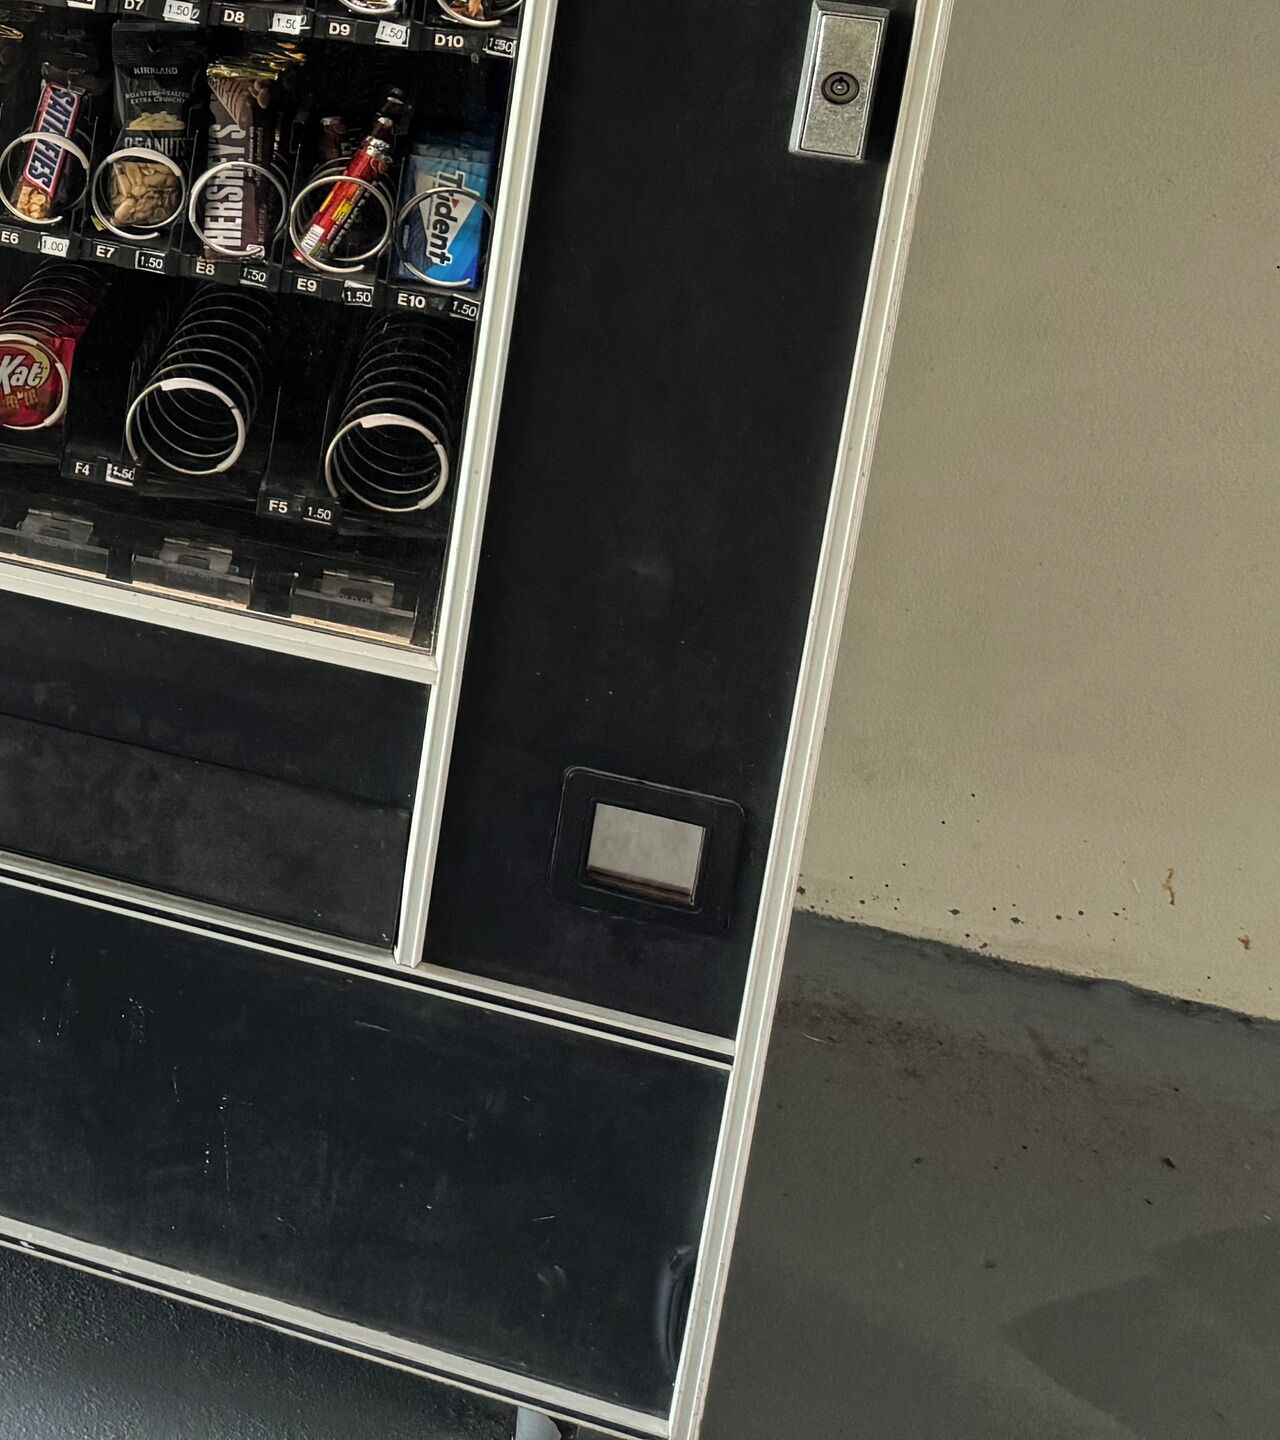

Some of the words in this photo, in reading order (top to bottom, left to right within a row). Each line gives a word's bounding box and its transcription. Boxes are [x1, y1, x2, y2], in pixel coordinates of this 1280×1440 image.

[167, 4, 190, 17] 1.50
[224, 10, 245, 24] D8
[328, 22, 351, 36] D9
[378, 25, 404, 40] 1.50
[434, 34, 464, 48] D10
[133, 66, 178, 75] KIRKLAND
[0, 232, 19, 244] E6
[96, 245, 115, 258] E7
[140, 257, 163, 269] 1.50
[196, 262, 215, 275] E8
[242, 268, 266, 282] 1.50
[297, 278, 317, 291] E9
[346, 291, 371, 303] 1.50
[397, 293, 426, 308] E10
[452, 300, 477, 317] 1.50
[74, 461, 90, 476] F4
[268, 499, 288, 514] F5
[307, 506, 332, 520] 1.50
